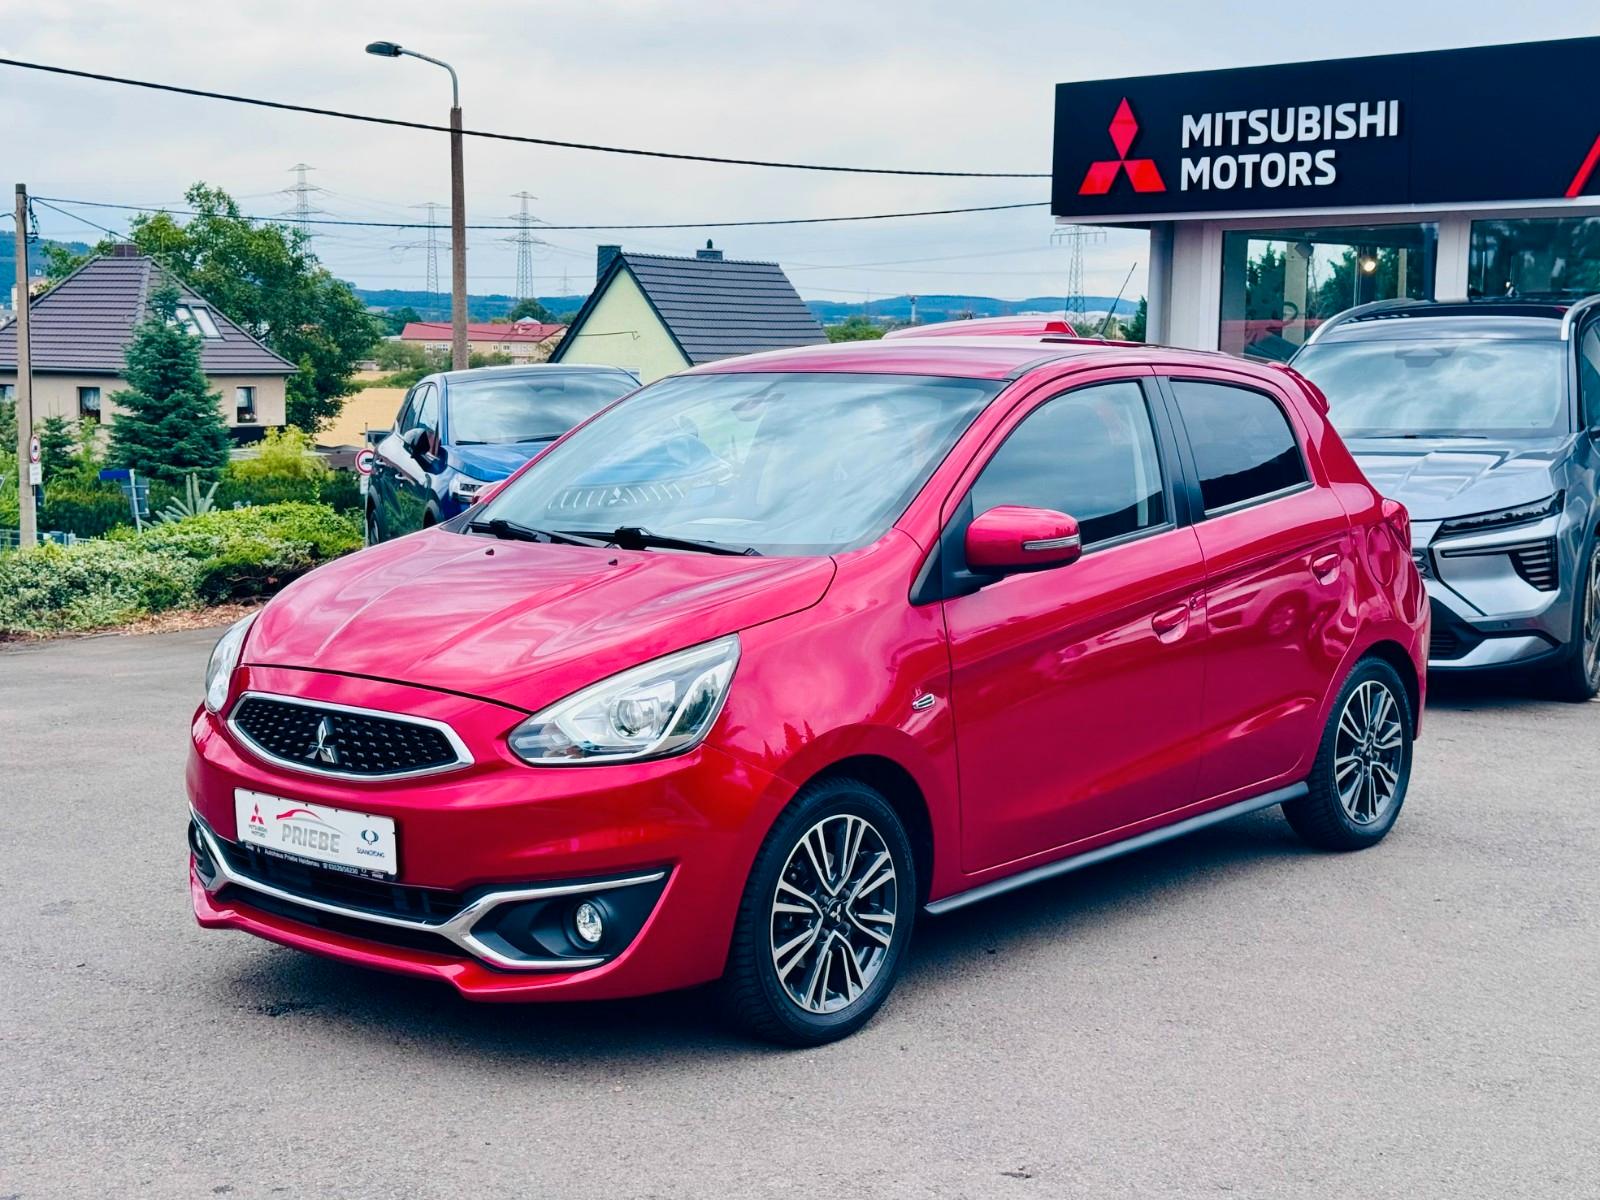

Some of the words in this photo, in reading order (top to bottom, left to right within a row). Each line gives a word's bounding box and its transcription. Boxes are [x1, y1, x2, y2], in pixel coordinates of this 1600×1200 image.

[1182, 100, 1398, 149] MITSUBISHI
[1180, 149, 1337, 192] MOTORS
[282, 823, 341, 853] PRIEBE
